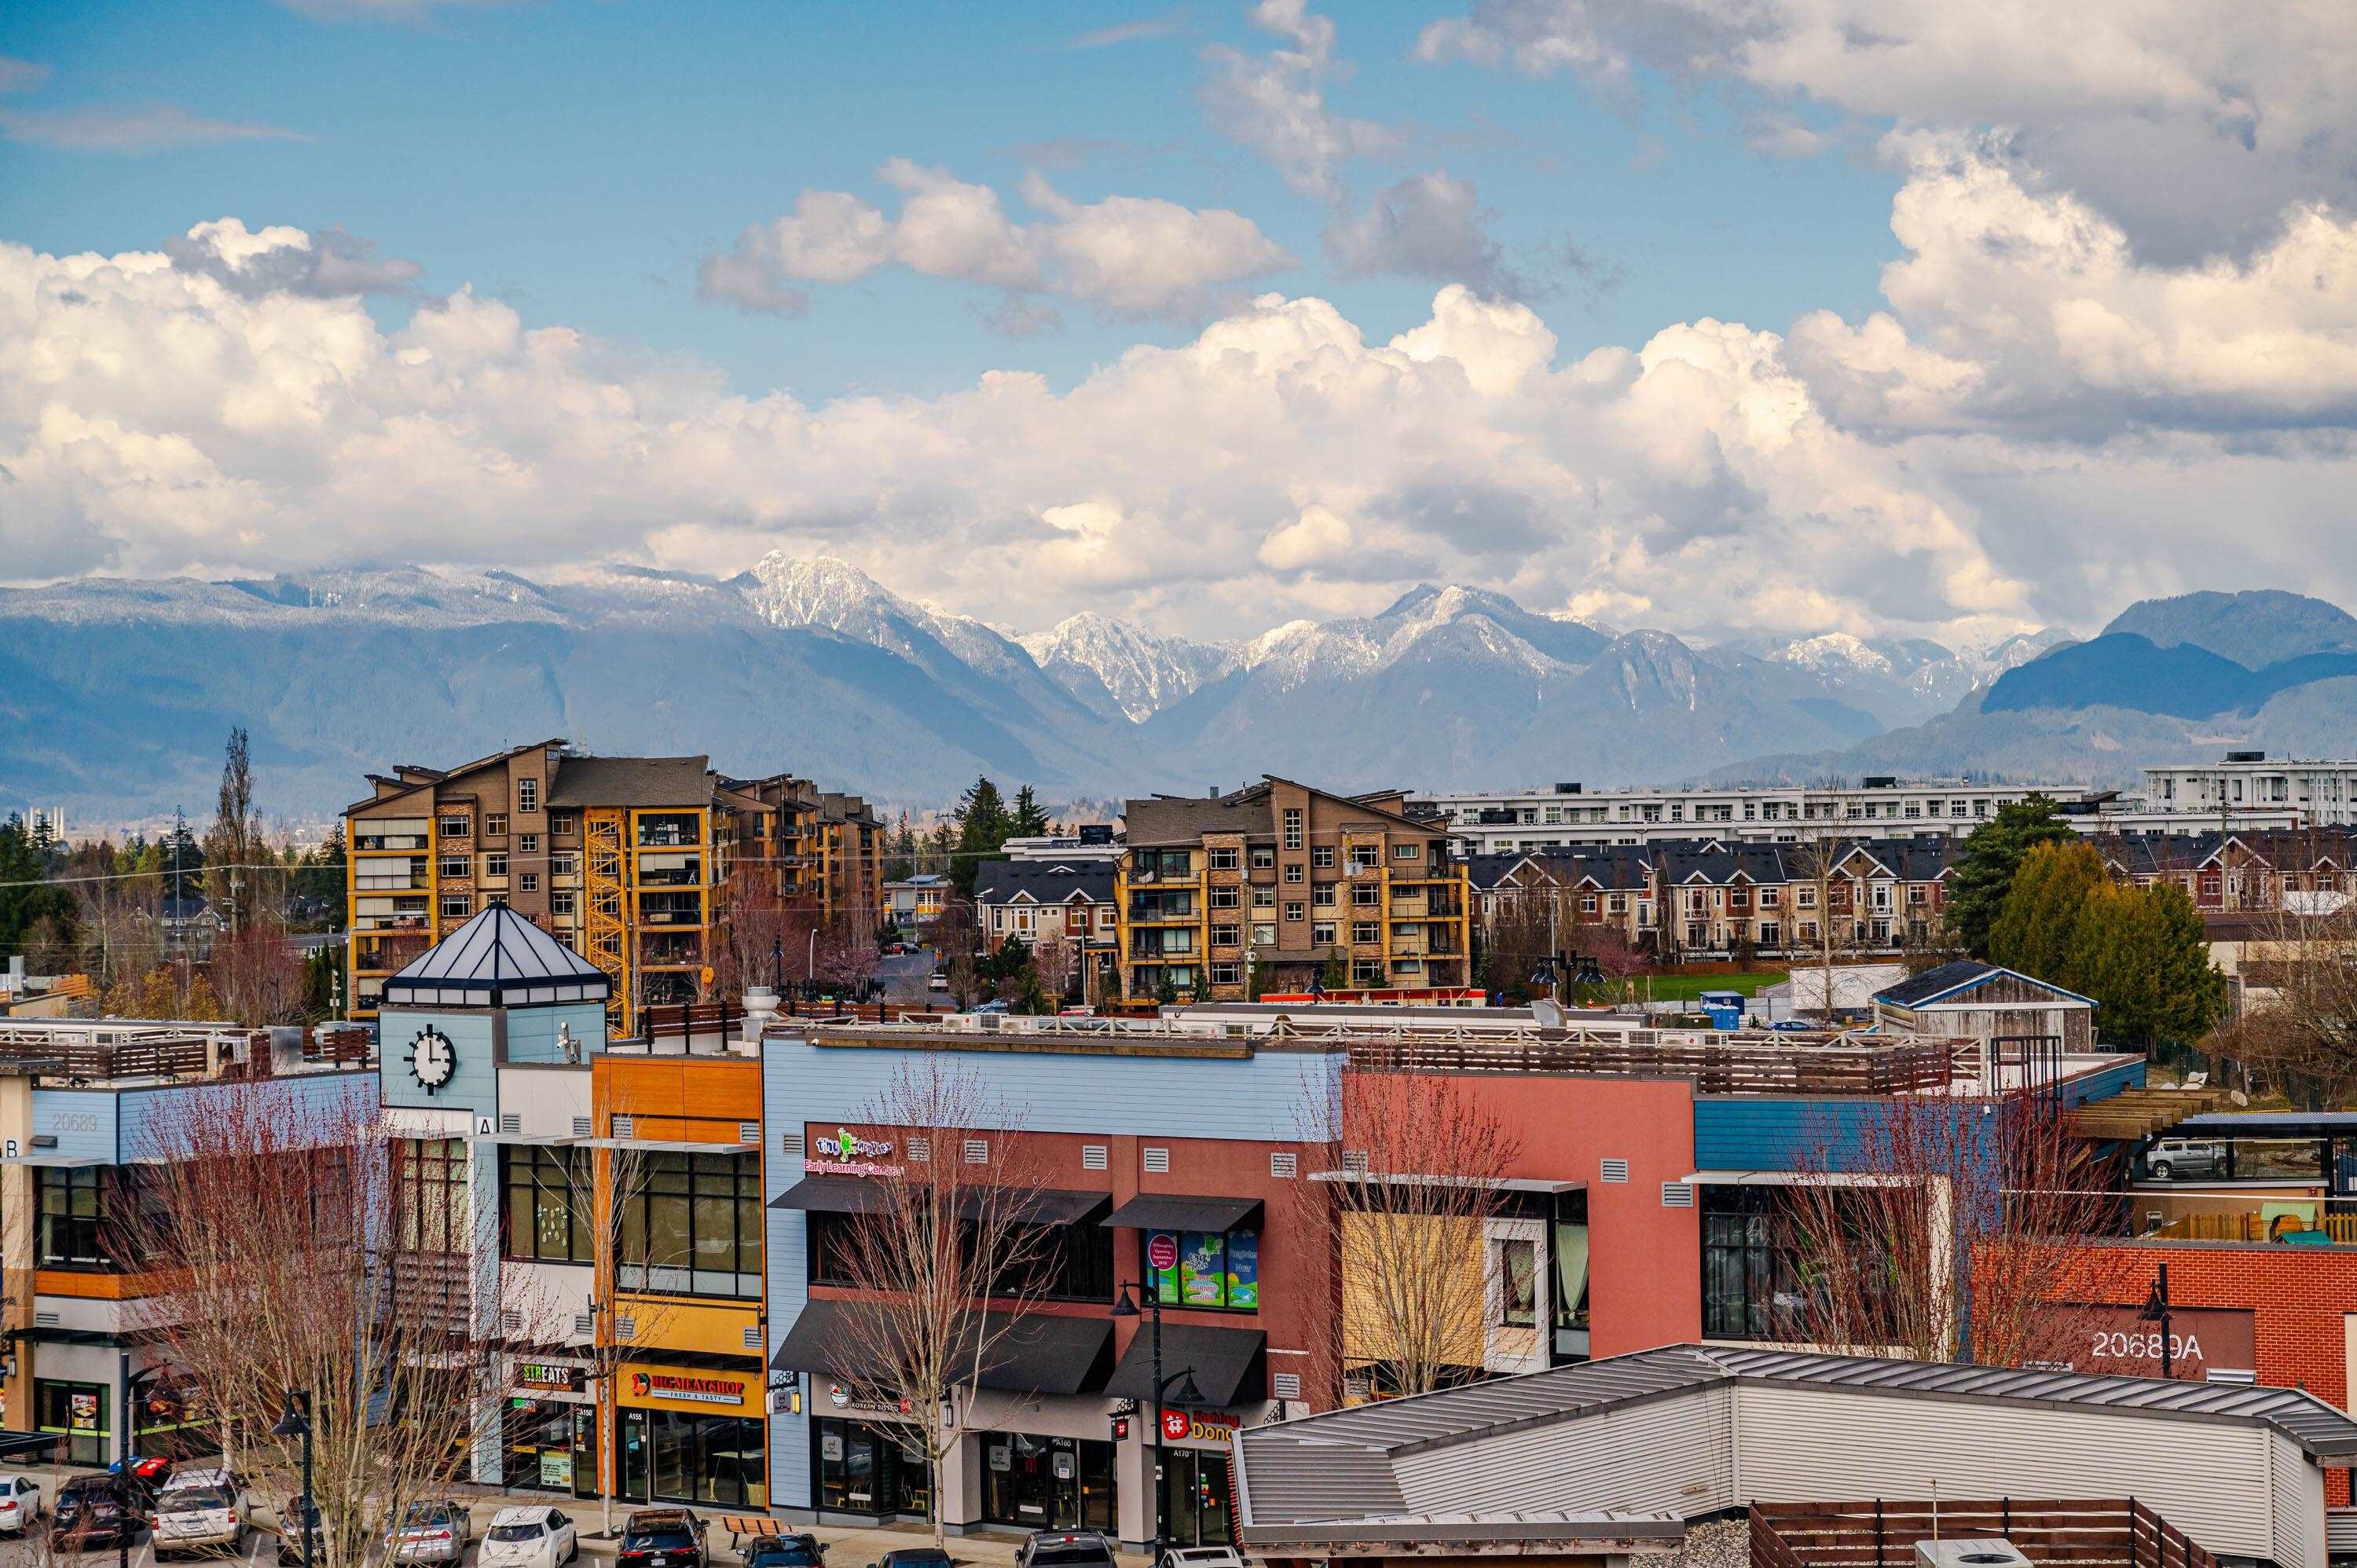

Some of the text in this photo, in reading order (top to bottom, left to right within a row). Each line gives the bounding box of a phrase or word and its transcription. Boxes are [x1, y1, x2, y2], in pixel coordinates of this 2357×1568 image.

[52, 1112, 97, 1131] 20689
[480, 1119, 490, 1134] A
[6, 1140, 17, 1158] B
[805, 1160, 827, 1175] Early
[827, 1160, 865, 1177] Learning
[2092, 1332, 2203, 1361] 20689A
[523, 1364, 569, 1384] STREATS
[651, 1376, 745, 1394] BIG MEAT SHOP
[580, 1408, 592, 1416] A150
[1173, 1449, 1189, 1458] A170
